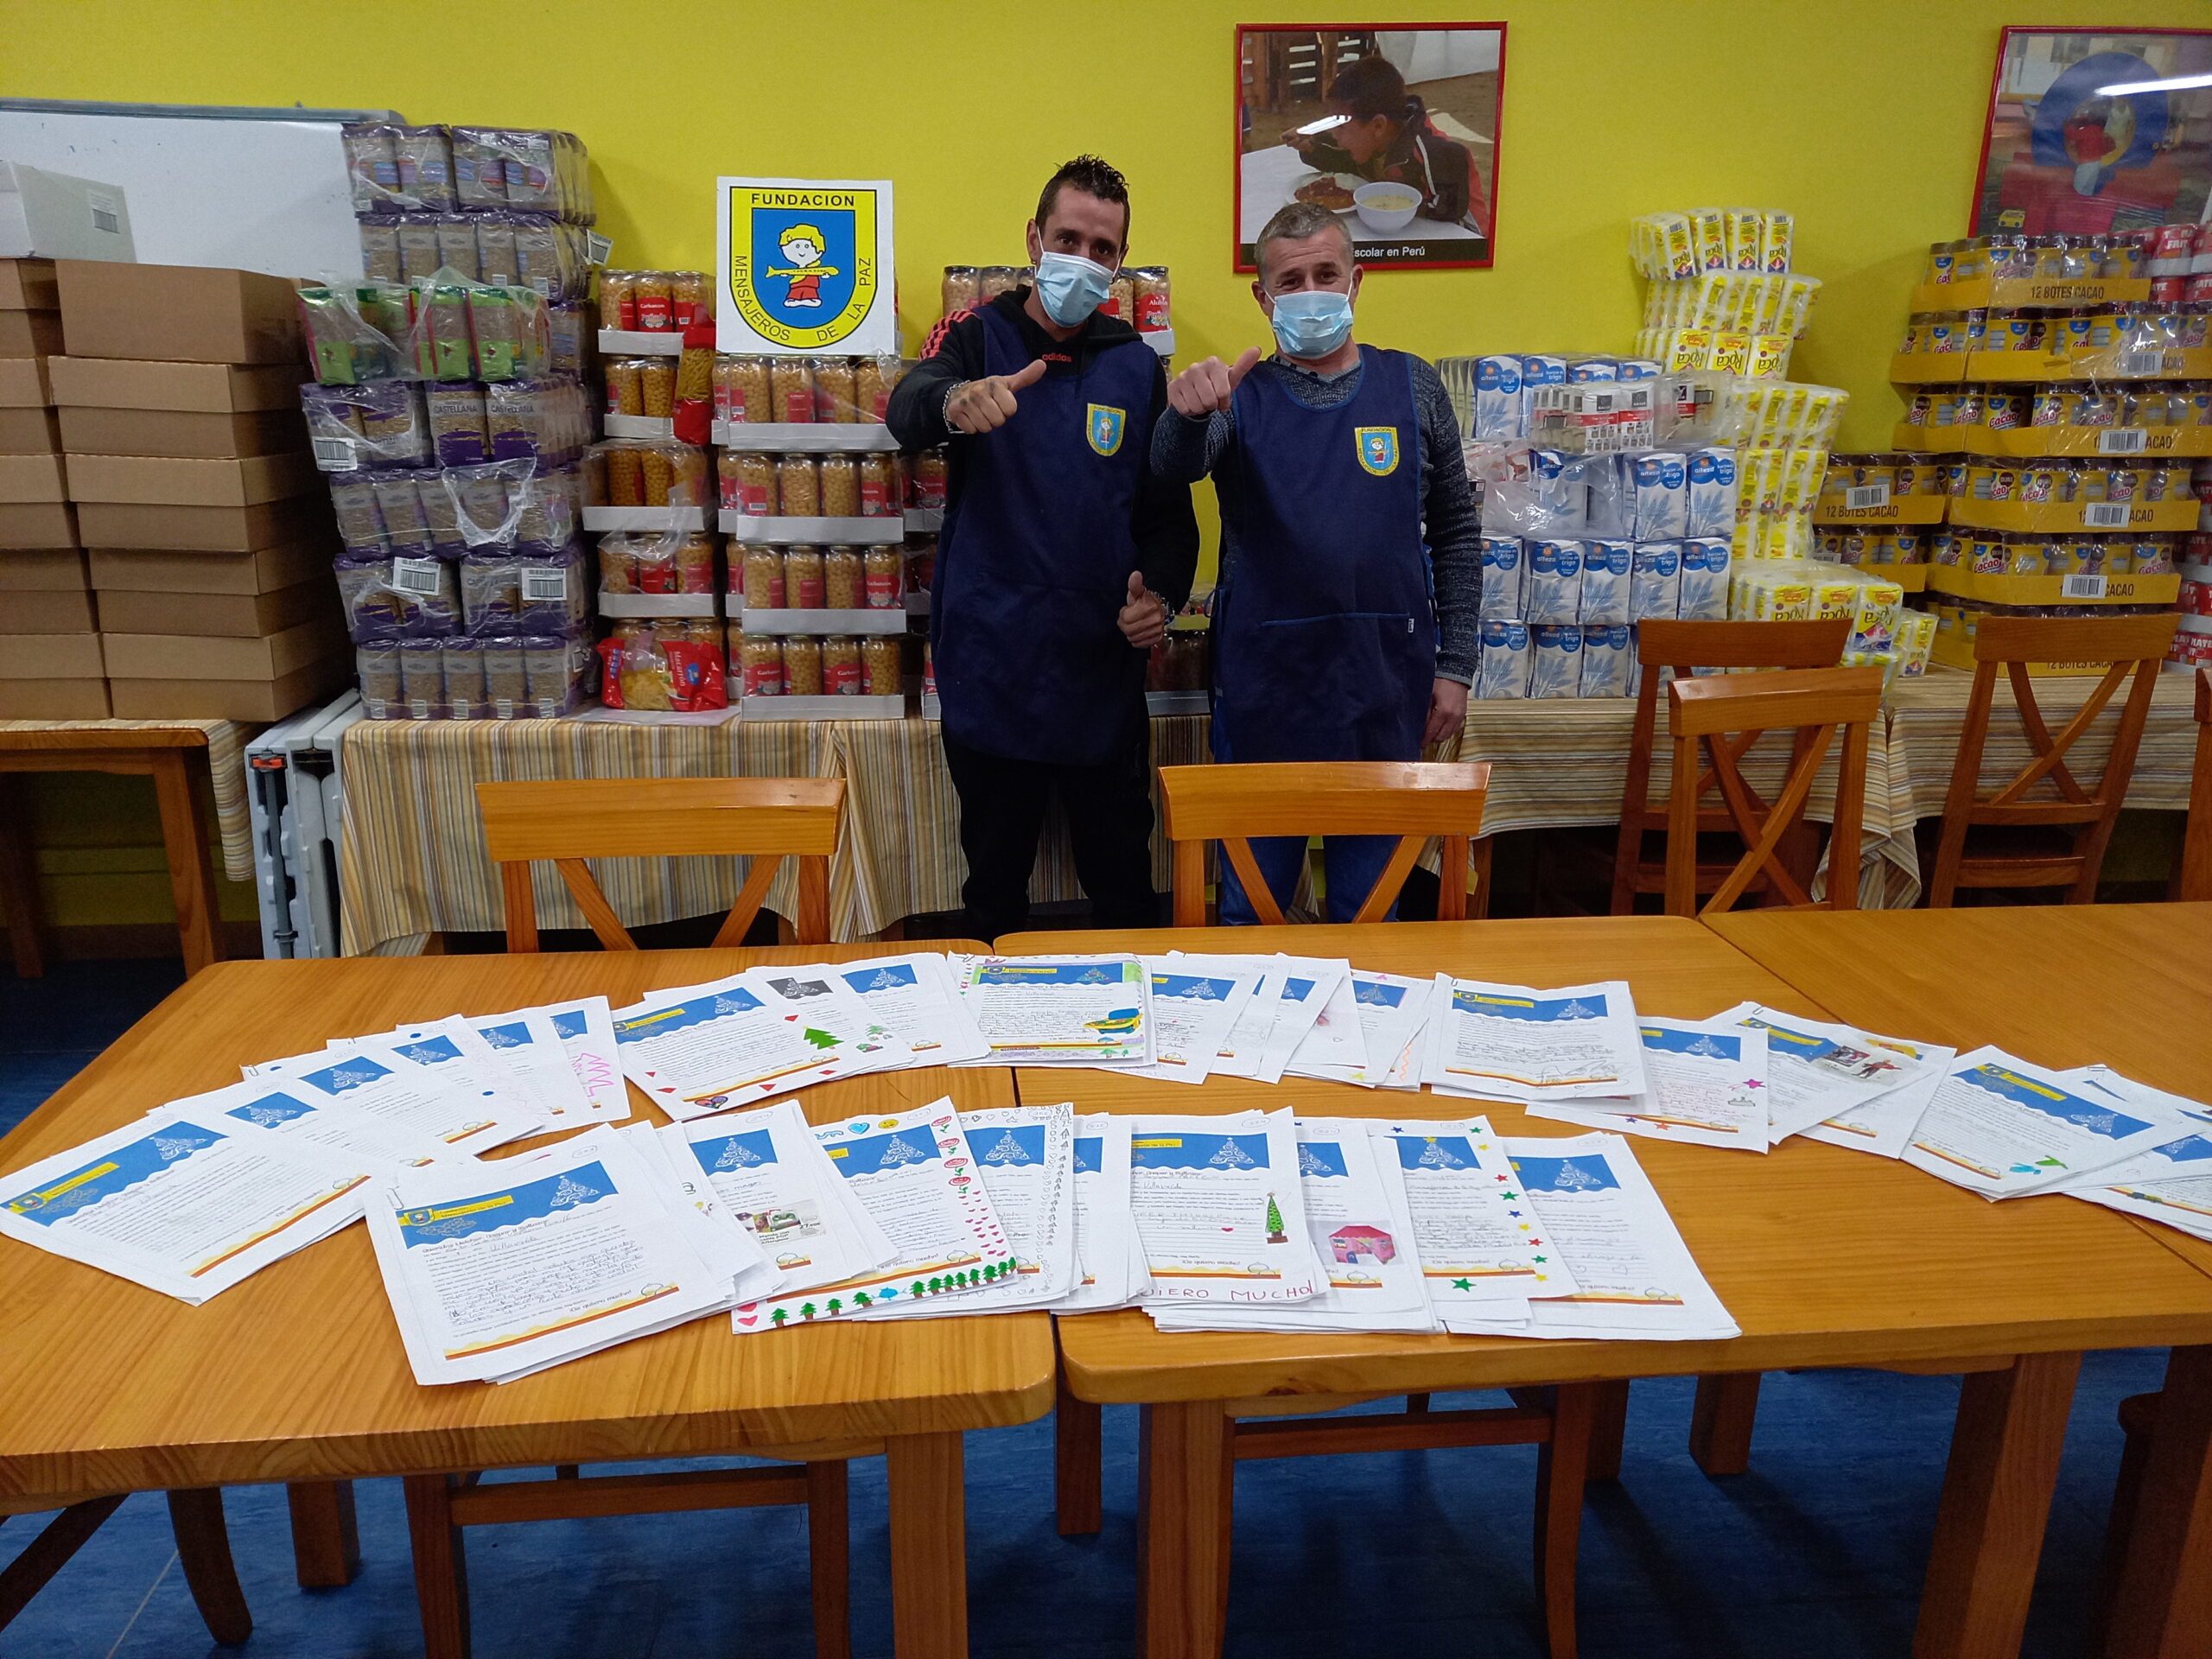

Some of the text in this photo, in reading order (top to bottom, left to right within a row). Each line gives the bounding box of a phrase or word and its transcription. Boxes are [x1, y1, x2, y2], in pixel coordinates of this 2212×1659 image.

[752, 193, 855, 207] FUNDACION
[1354, 246, 1425, 257] scolar en Perú
[734, 256, 871, 342] MENSAJEROS DE LA PAZ
[2031, 286, 2105, 299] 12 BOTES CACAO
[1042, 353, 1072, 362] adidas
[1677, 349, 1706, 367] Roca
[1716, 349, 1743, 368] Roca
[435, 405, 478, 414] CASTELLANA
[1989, 412, 2018, 429] Cacao
[2146, 435, 2172, 449] ACAO
[1826, 505, 1836, 518] 12
[1869, 505, 1899, 518] CACAO
[2129, 509, 2154, 523] ACAO
[1974, 558, 1999, 573] Cacao
